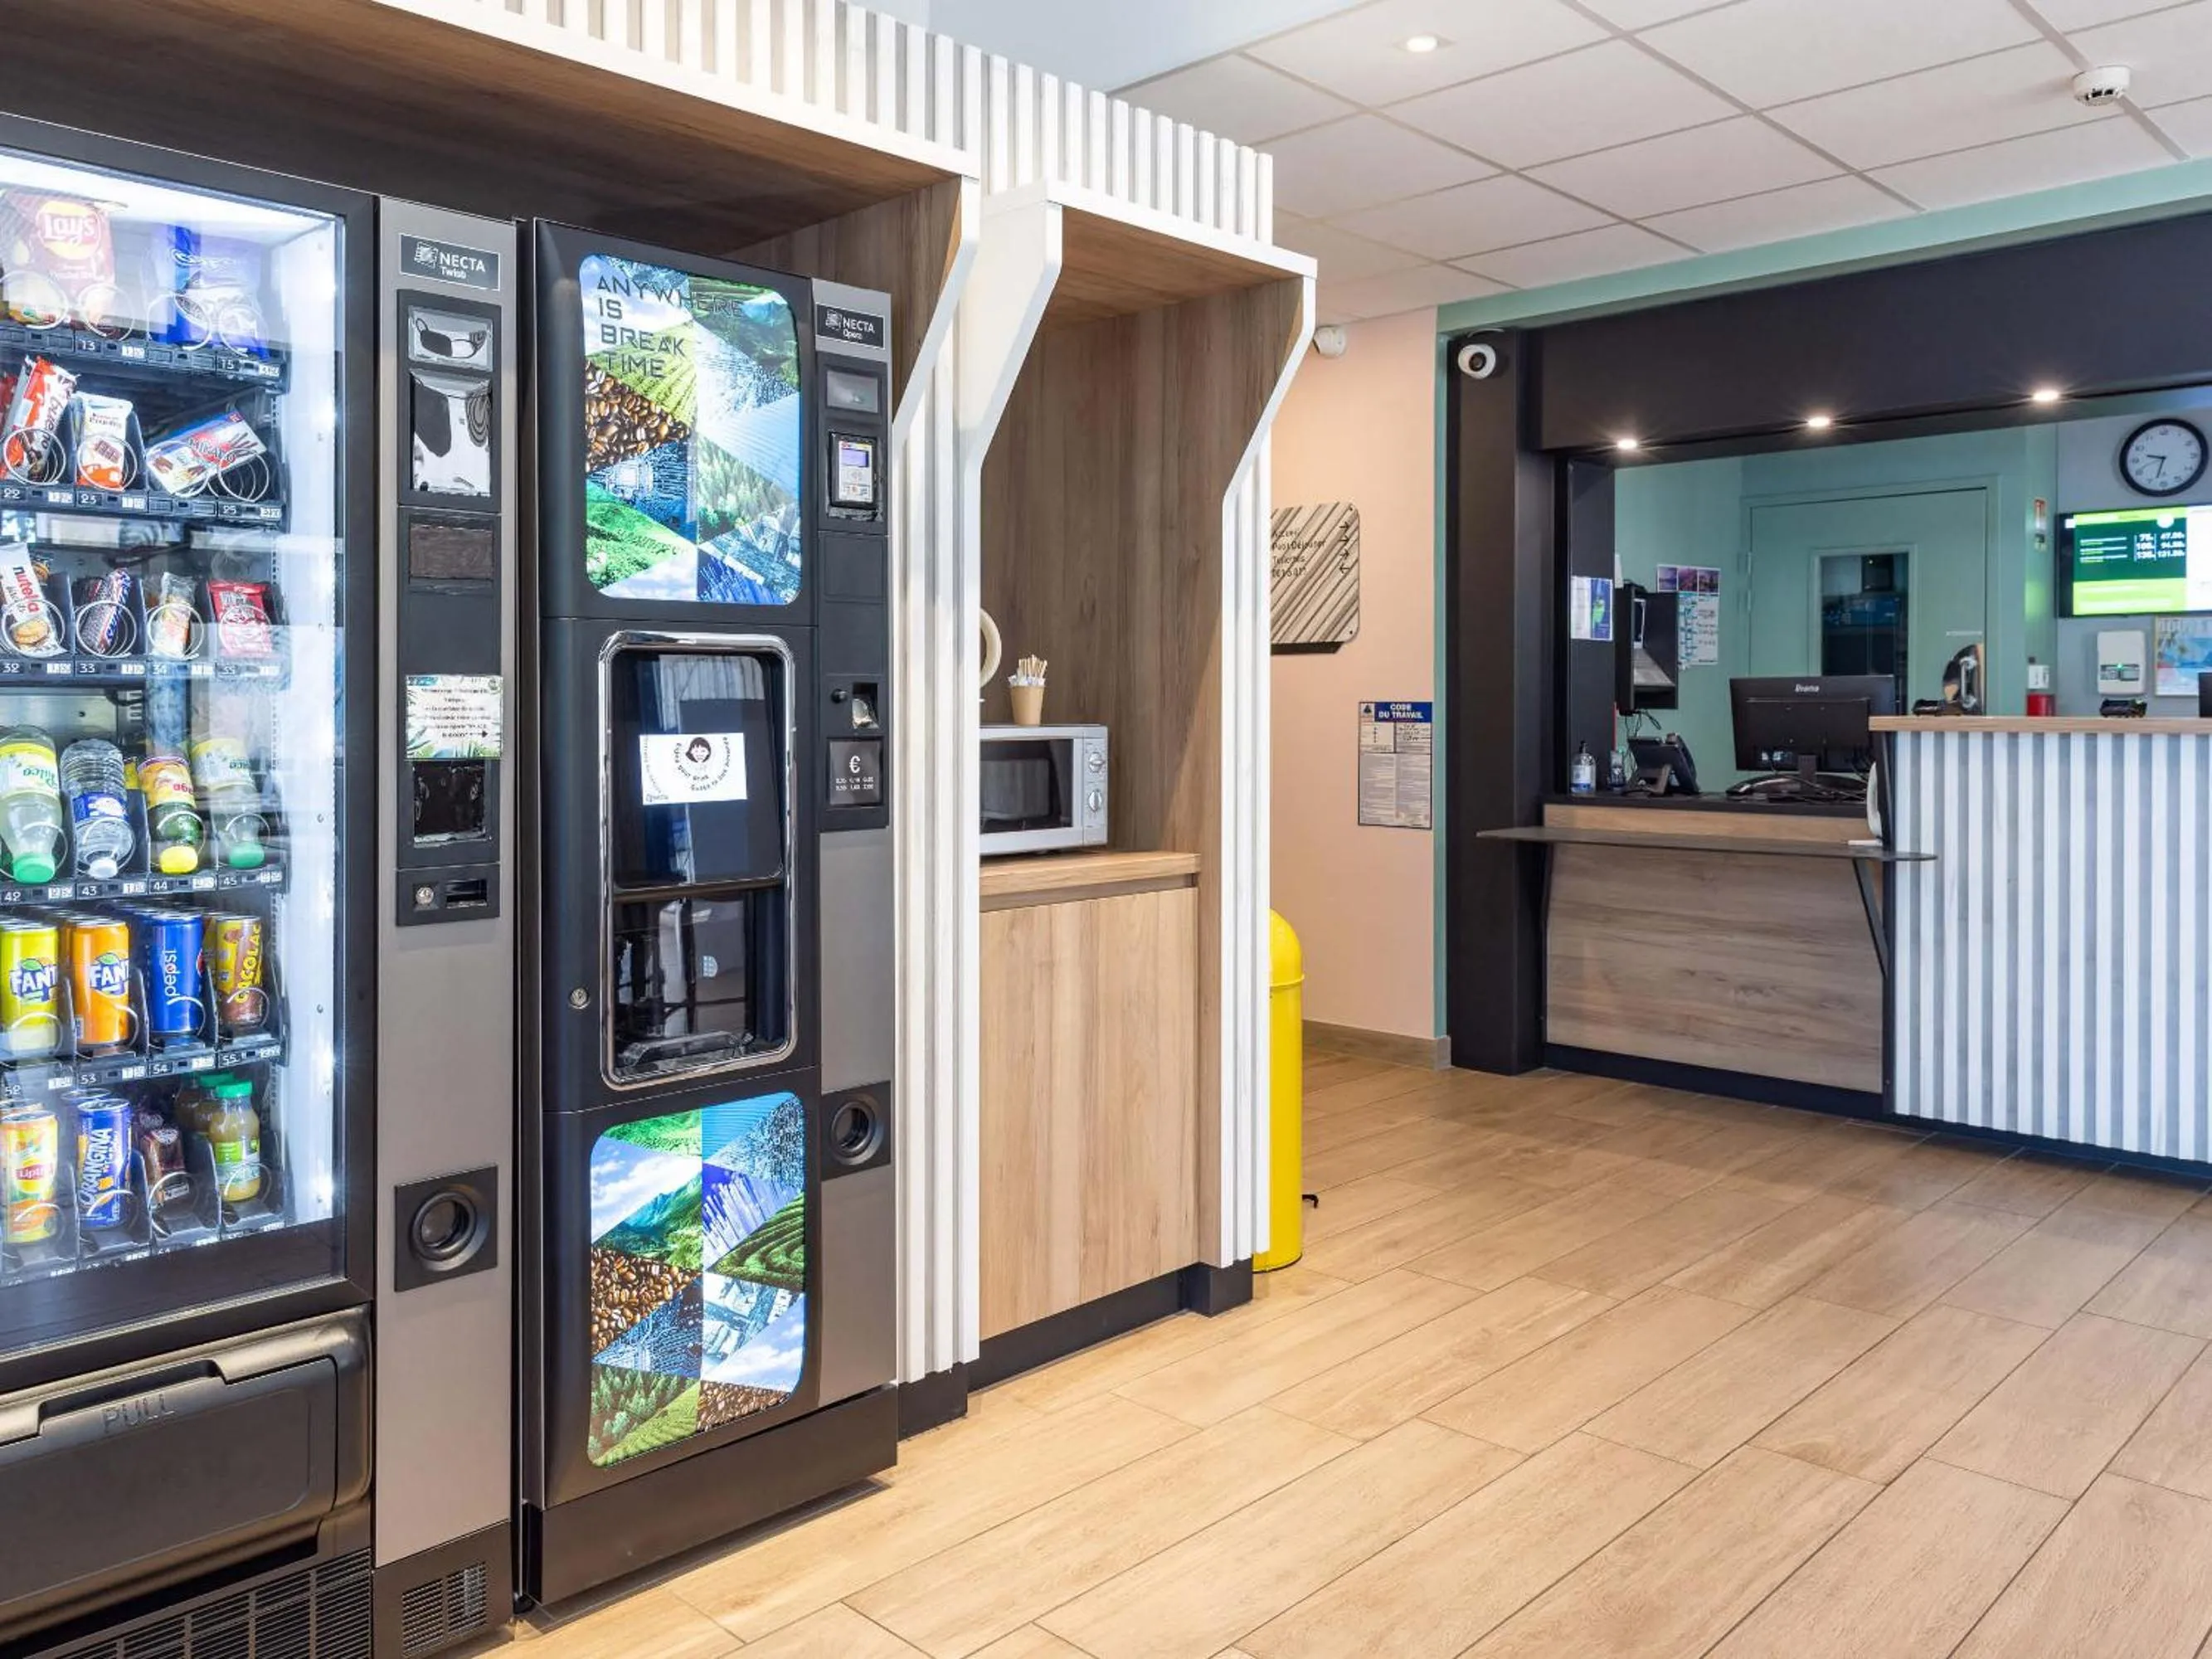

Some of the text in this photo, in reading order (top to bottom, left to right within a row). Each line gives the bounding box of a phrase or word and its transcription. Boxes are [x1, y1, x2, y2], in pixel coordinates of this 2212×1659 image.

[440, 251, 486, 272] NECTA
[596, 275, 744, 318] ANYWHERE
[599, 297, 622, 319] IS
[843, 317, 875, 333] NECTA
[81, 339, 95, 350] 13
[601, 324, 685, 357] BREAK
[602, 350, 665, 378] TIME
[41, 396, 64, 450] bueno
[13, 566, 41, 613] nutela
[849, 755, 860, 773] €
[4, 891, 22, 902] 42
[82, 885, 97, 896] 43
[153, 881, 168, 891] 44
[10, 964, 57, 996] FANT
[90, 960, 129, 988] FAN
[163, 949, 177, 997] pepsi
[80, 1073, 97, 1085] 53
[80, 1128, 113, 1205] ORANGINA
[100, 1393, 175, 1433] PULL
